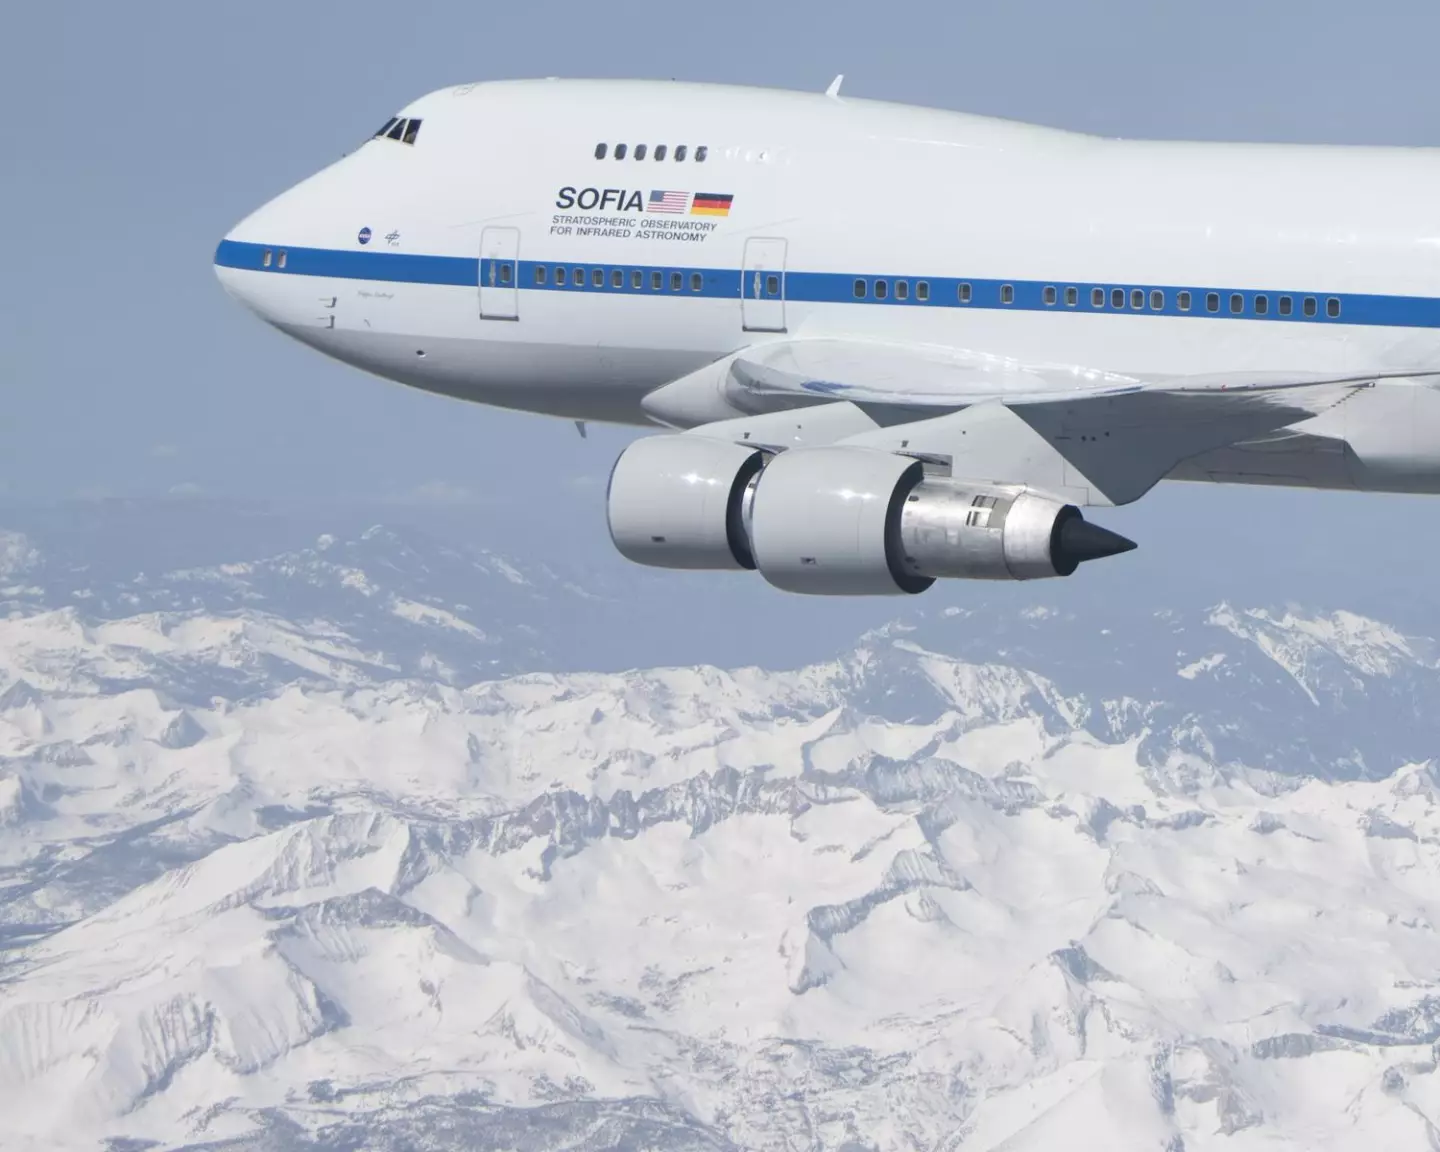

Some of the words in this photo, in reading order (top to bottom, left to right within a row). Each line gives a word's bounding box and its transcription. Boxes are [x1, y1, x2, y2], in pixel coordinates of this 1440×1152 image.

[555, 186, 643, 212] SOFIA
[552, 214, 637, 228] STRATOSPHERIC
[640, 219, 718, 232] OBSERVATORY
[550, 226, 573, 236] FOR
[576, 227, 632, 238] INFRARED
[635, 230, 708, 242] ASTRONOMY
